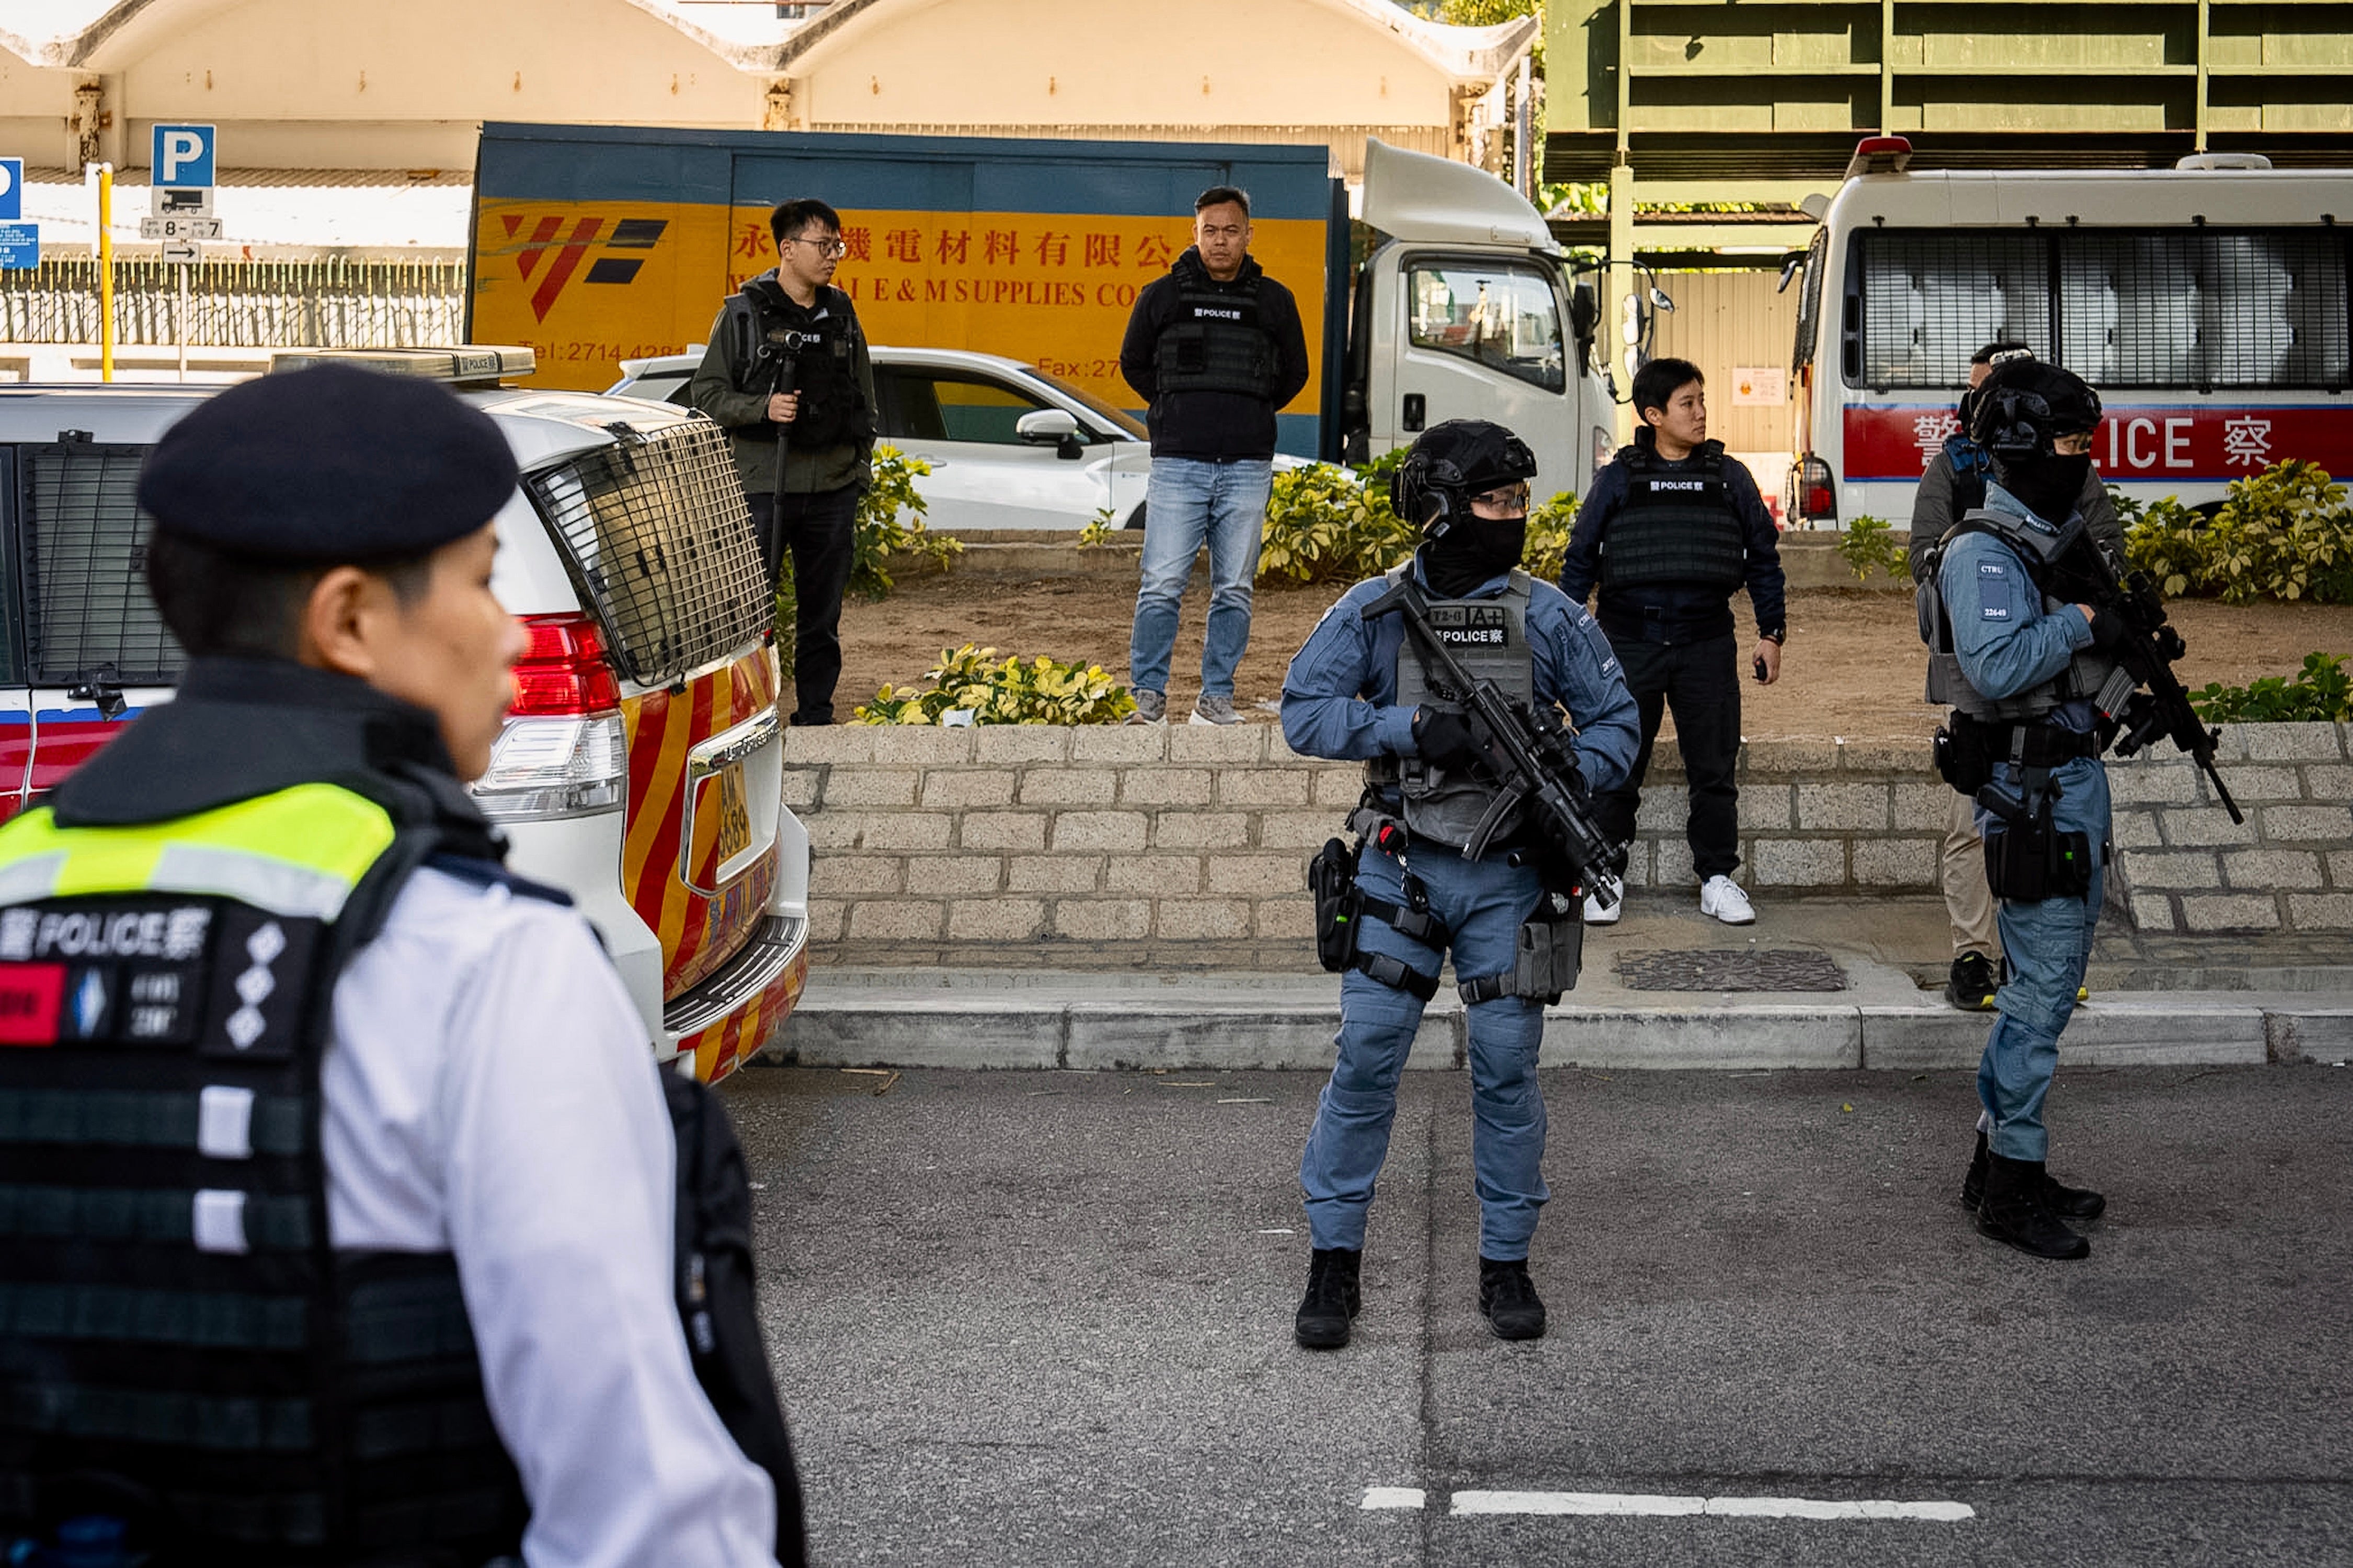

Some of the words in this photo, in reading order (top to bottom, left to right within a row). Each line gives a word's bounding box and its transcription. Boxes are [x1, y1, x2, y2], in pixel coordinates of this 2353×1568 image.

[163, 131, 203, 181] P
[165, 221, 176, 236] 8
[209, 222, 219, 236] 7
[2092, 418, 2194, 469] ICE
[2224, 415, 2271, 465] 察
